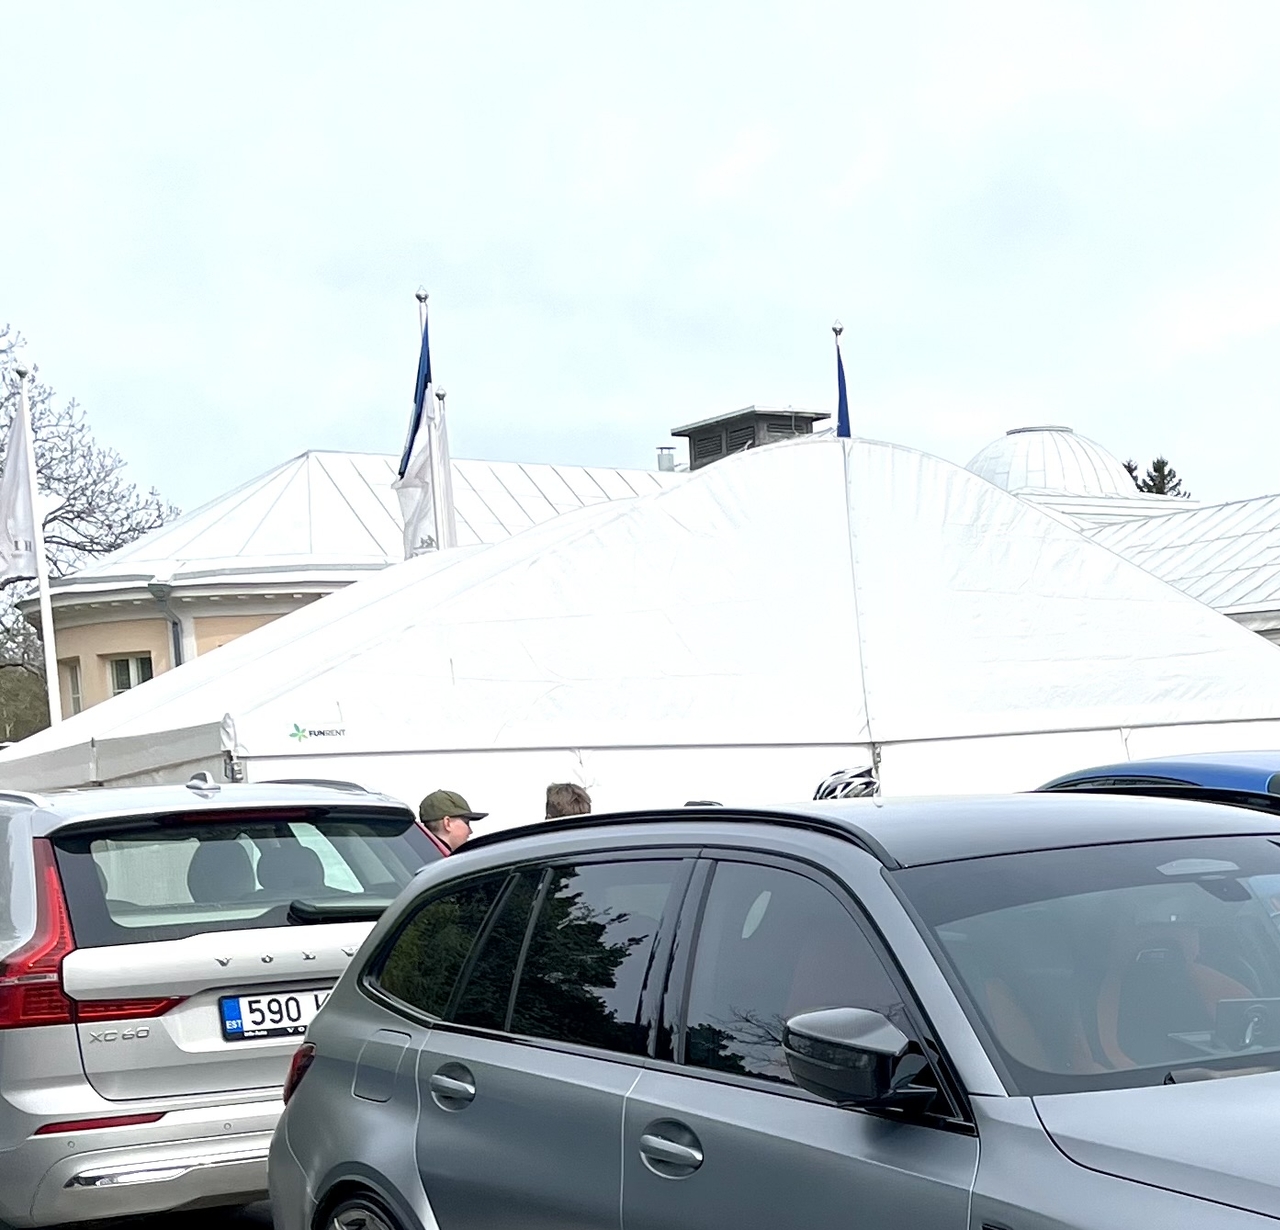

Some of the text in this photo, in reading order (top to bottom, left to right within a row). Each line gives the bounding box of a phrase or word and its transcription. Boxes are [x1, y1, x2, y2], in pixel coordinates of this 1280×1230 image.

[308, 729, 346, 737] FUNRENT
[214, 947, 358, 967] VOLV
[226, 1020, 242, 1030] EST
[247, 996, 302, 1026] 590
